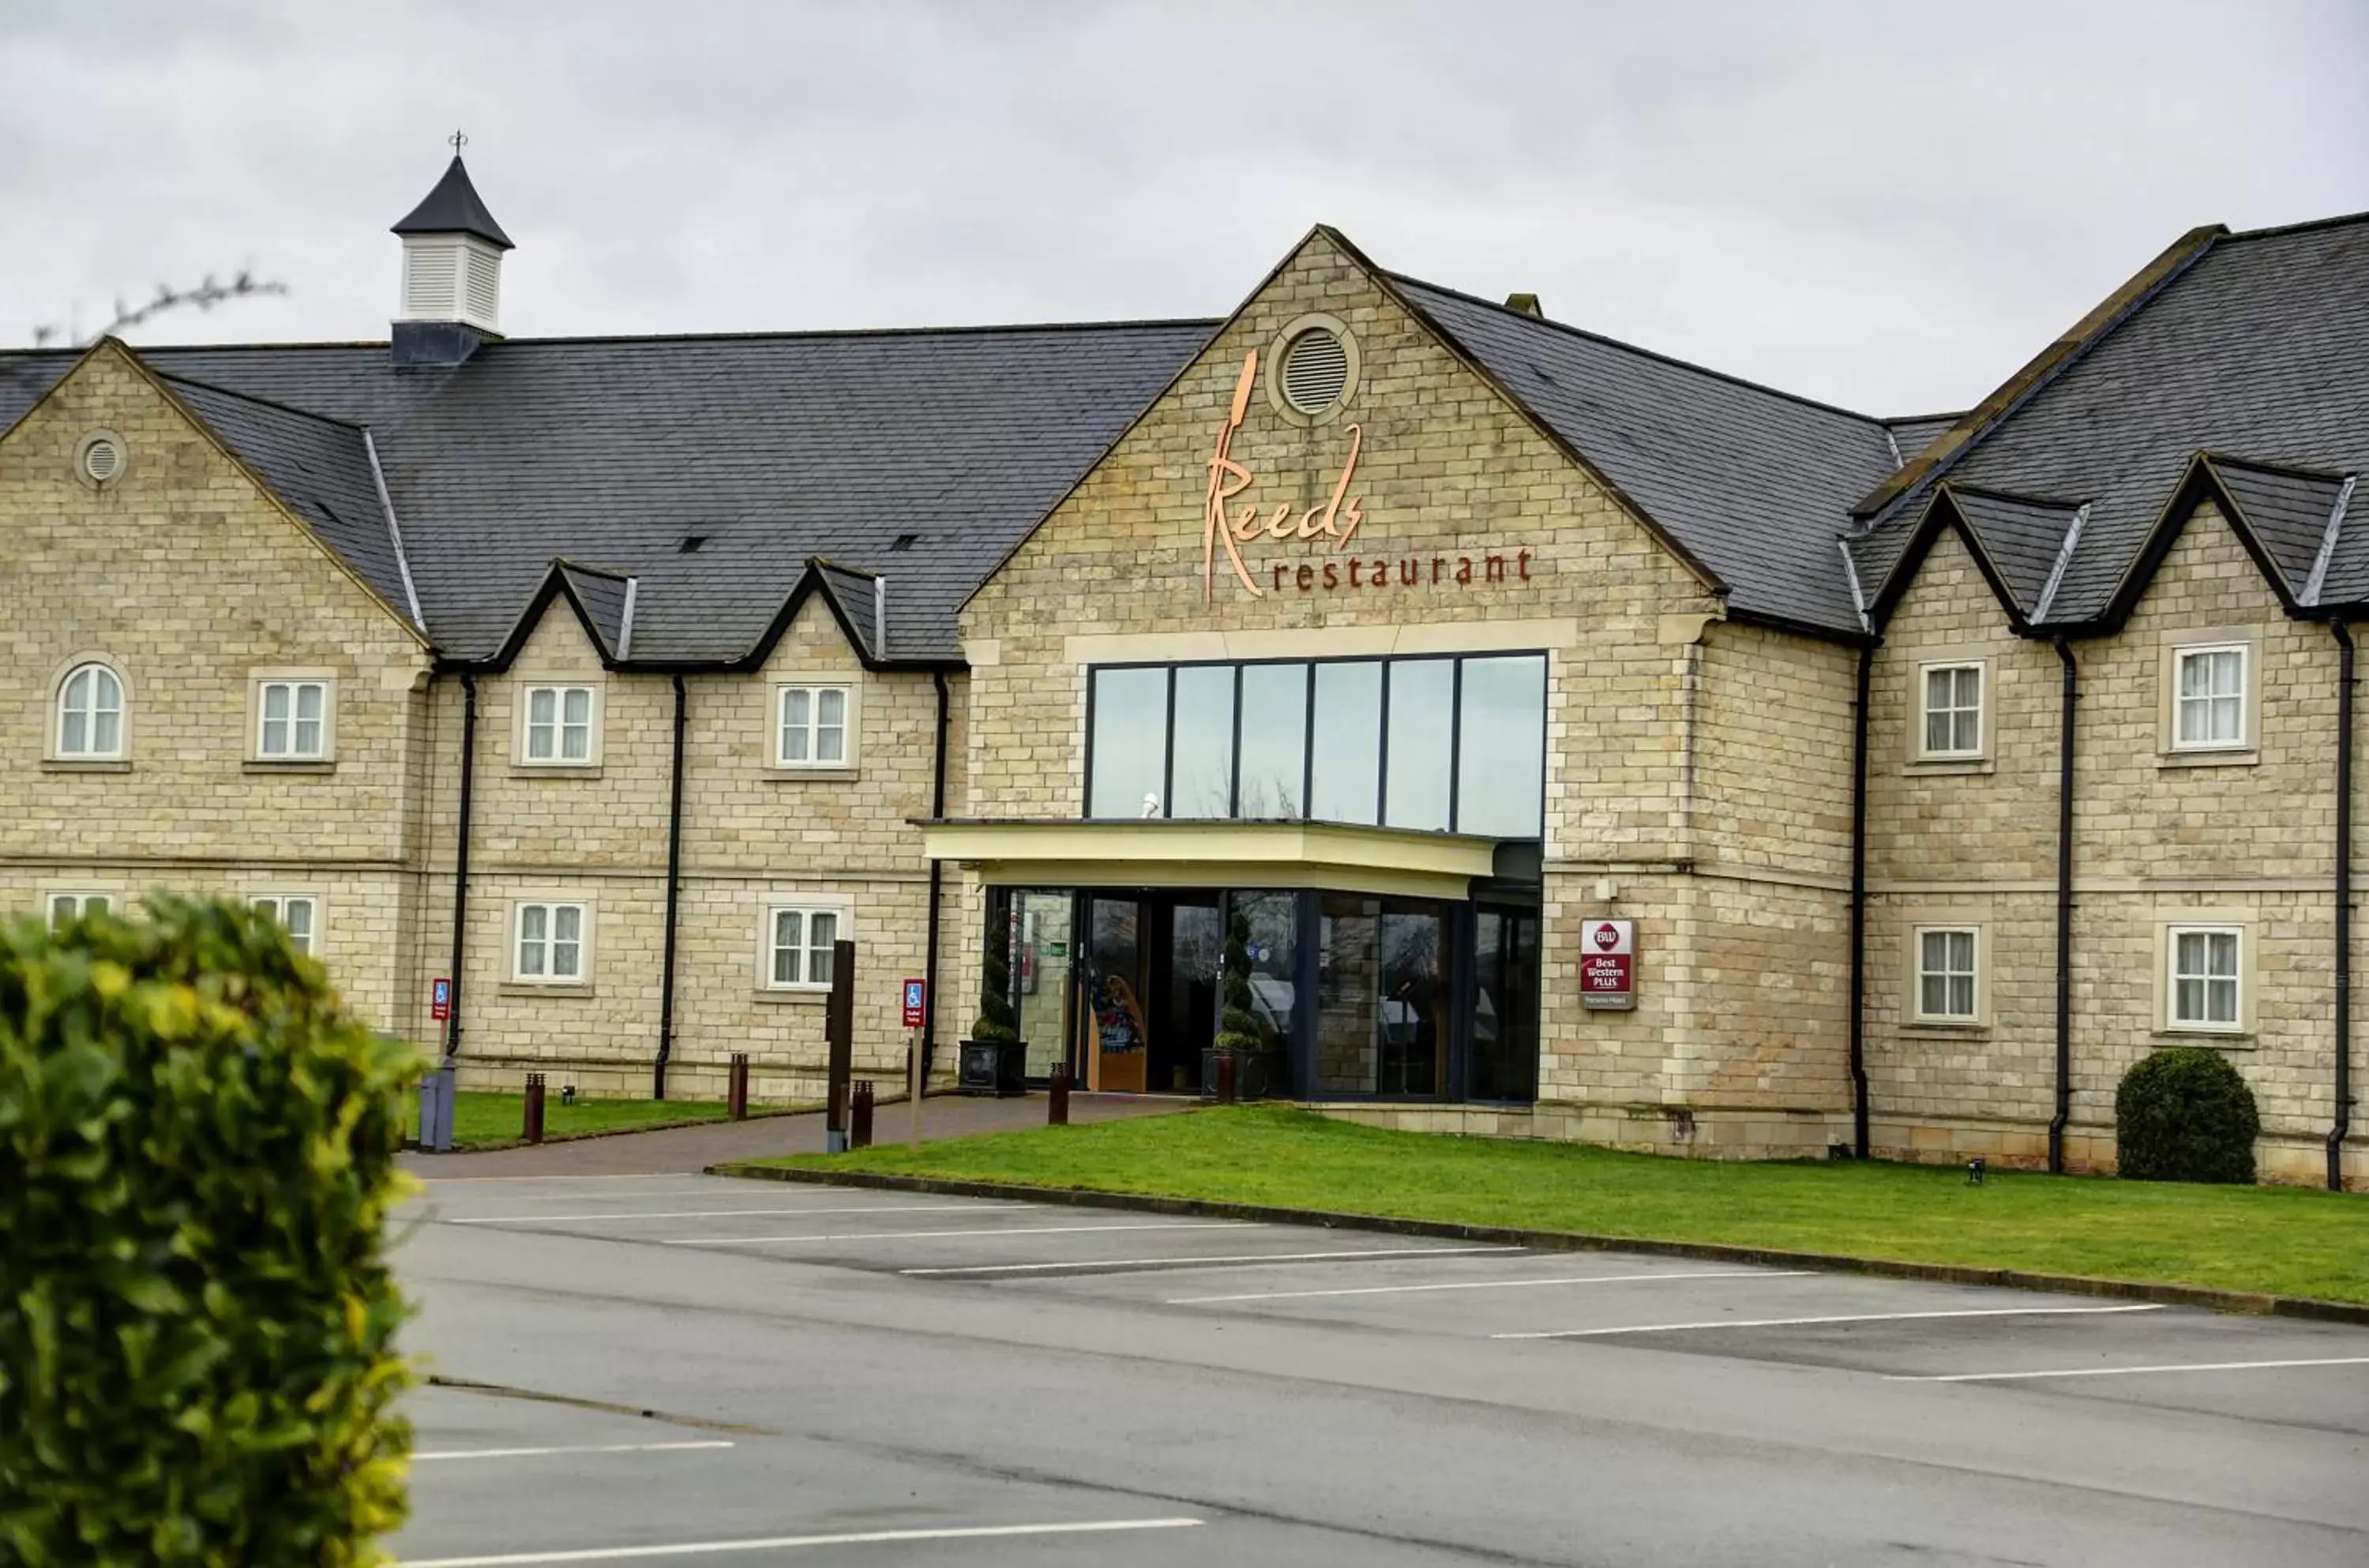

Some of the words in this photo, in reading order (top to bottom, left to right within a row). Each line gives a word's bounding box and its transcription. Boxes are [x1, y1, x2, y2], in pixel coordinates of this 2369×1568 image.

[1204, 348, 1363, 610] Reeds
[1273, 550, 1532, 592] restaurant
[1597, 931, 1616, 943] BW
[1596, 958, 1616, 967] Best
[1587, 967, 1624, 977] Western
[1593, 977, 1618, 986] PLUS
